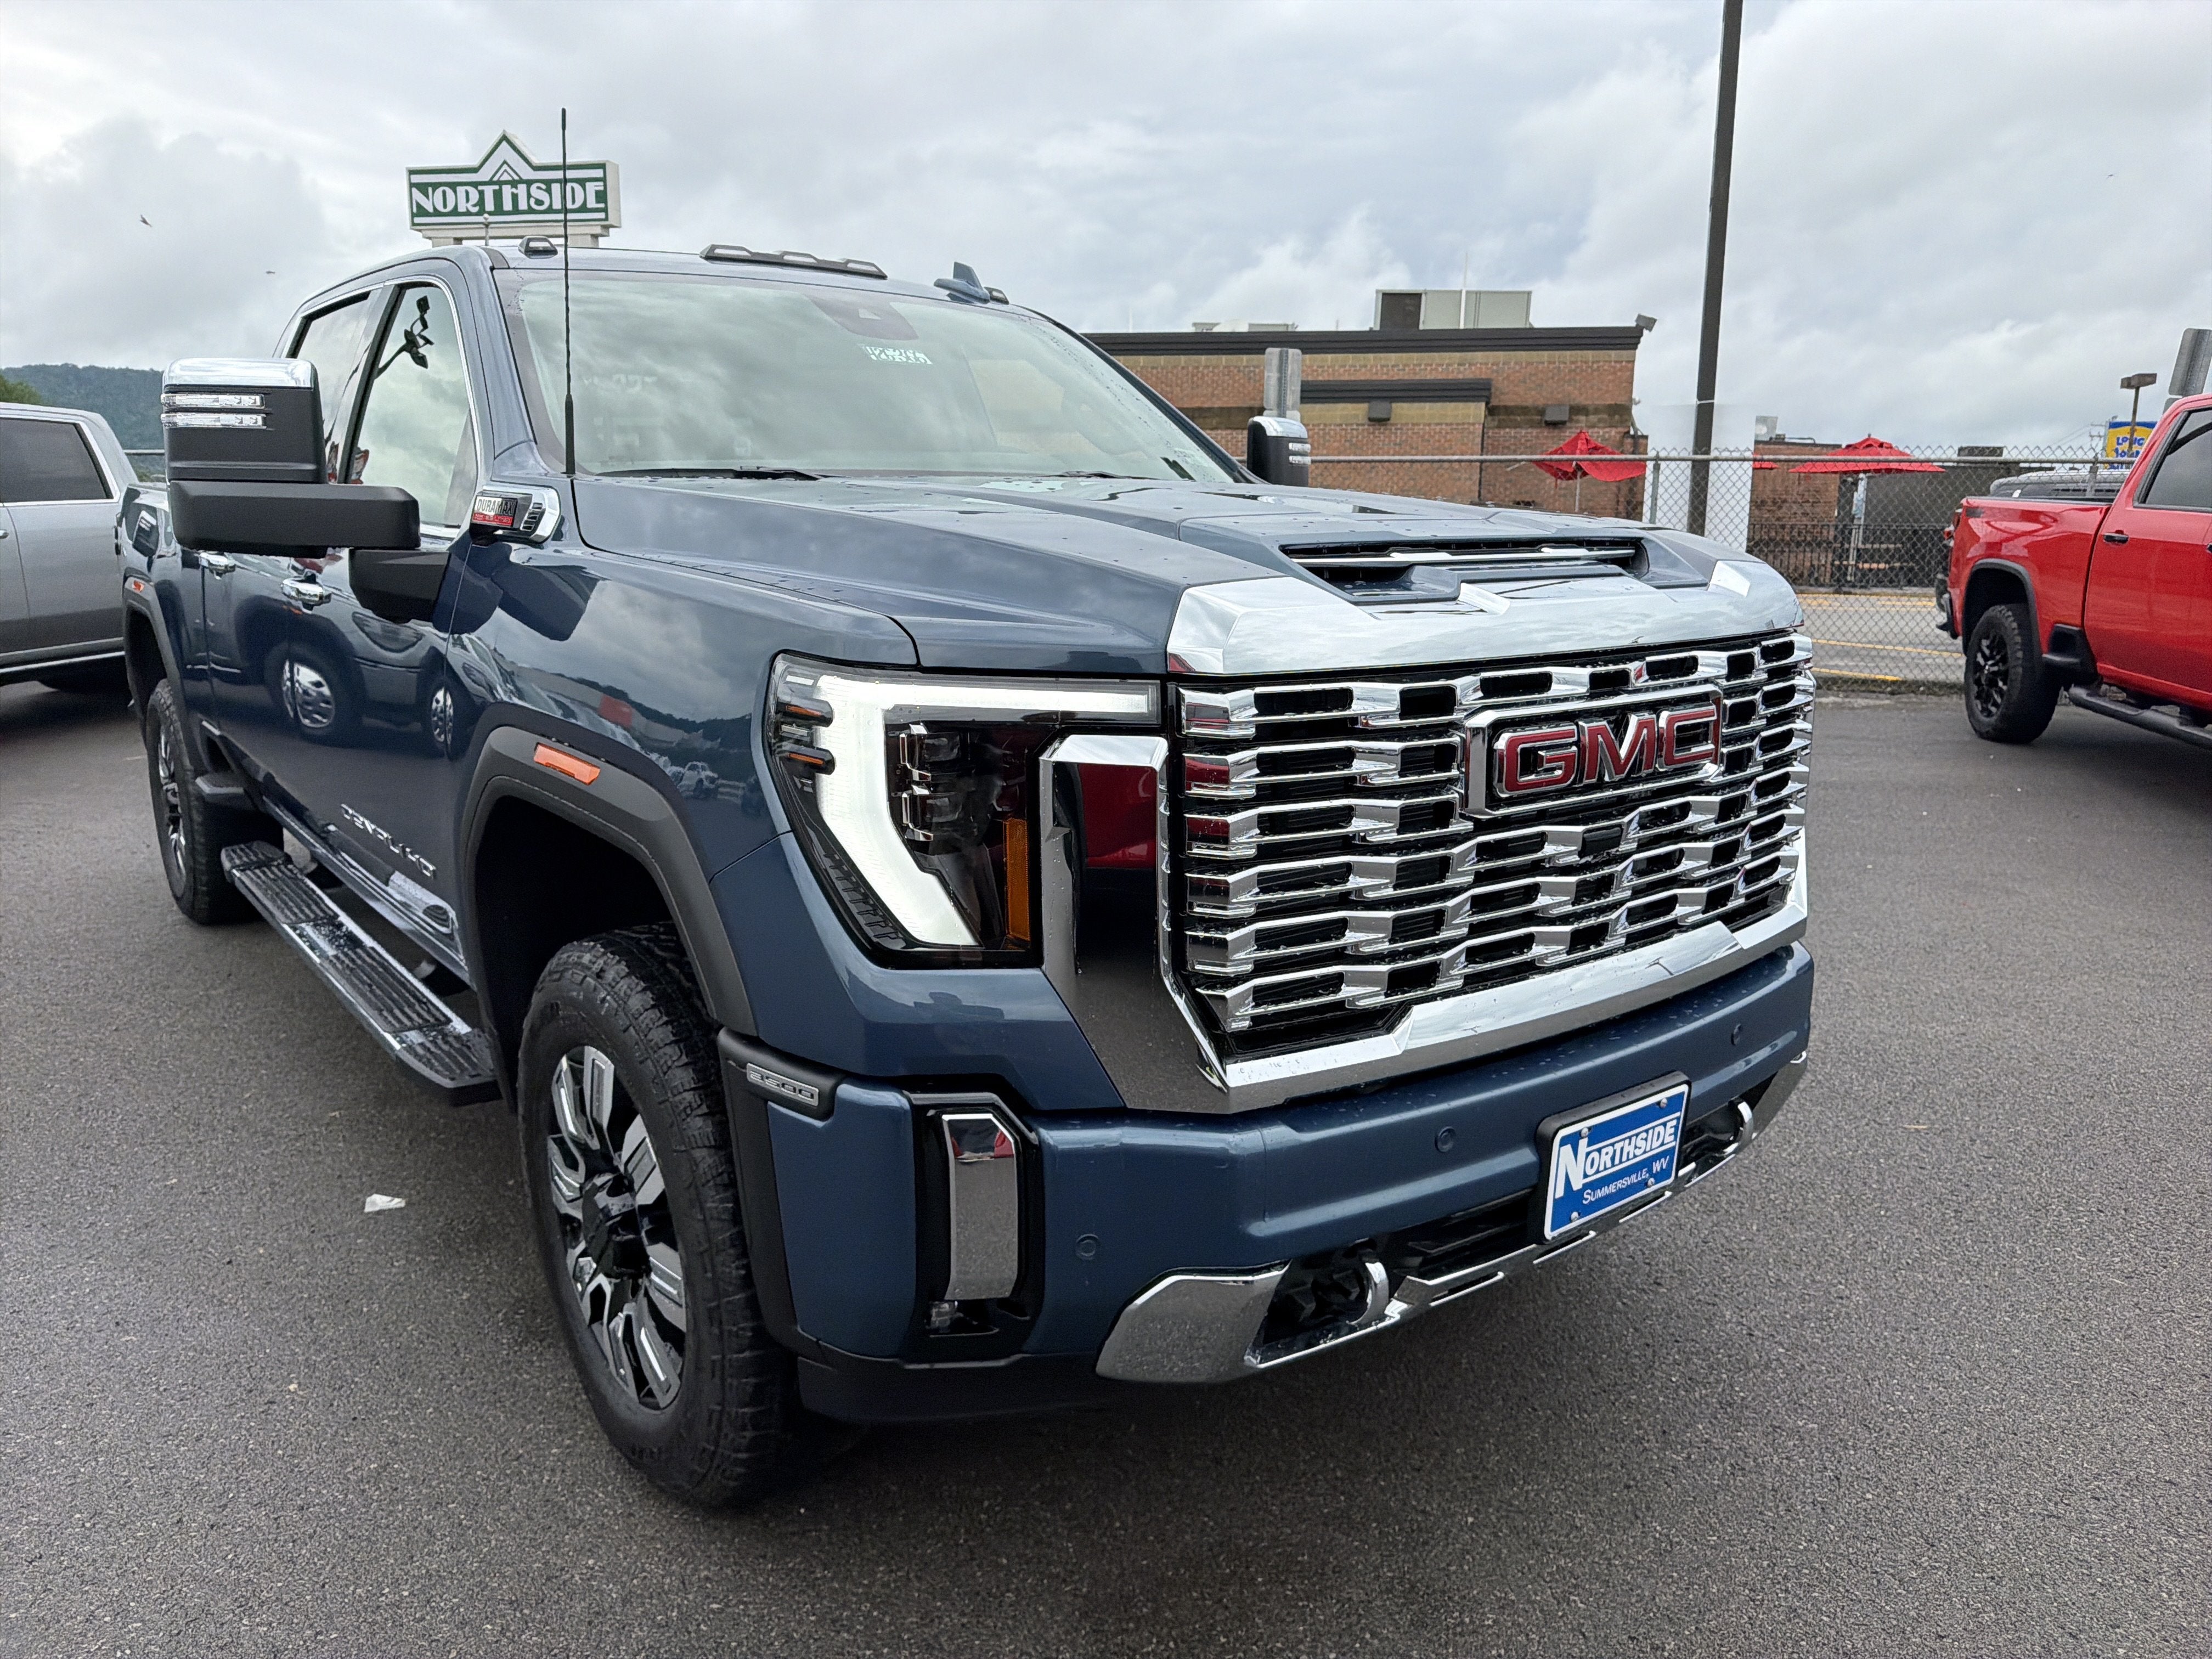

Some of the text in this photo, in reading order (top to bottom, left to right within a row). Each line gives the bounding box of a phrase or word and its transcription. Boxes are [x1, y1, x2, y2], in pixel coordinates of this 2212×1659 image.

[411, 182, 605, 213] NORTHSIDE
[476, 499, 517, 516] DURAMAX
[1493, 703, 1718, 797] GMC
[749, 1070, 814, 1101] 2500
[1555, 1119, 1677, 1199] NORTHSIDE
[1582, 1155, 1669, 1204] SUMMERSVILLE, WV
